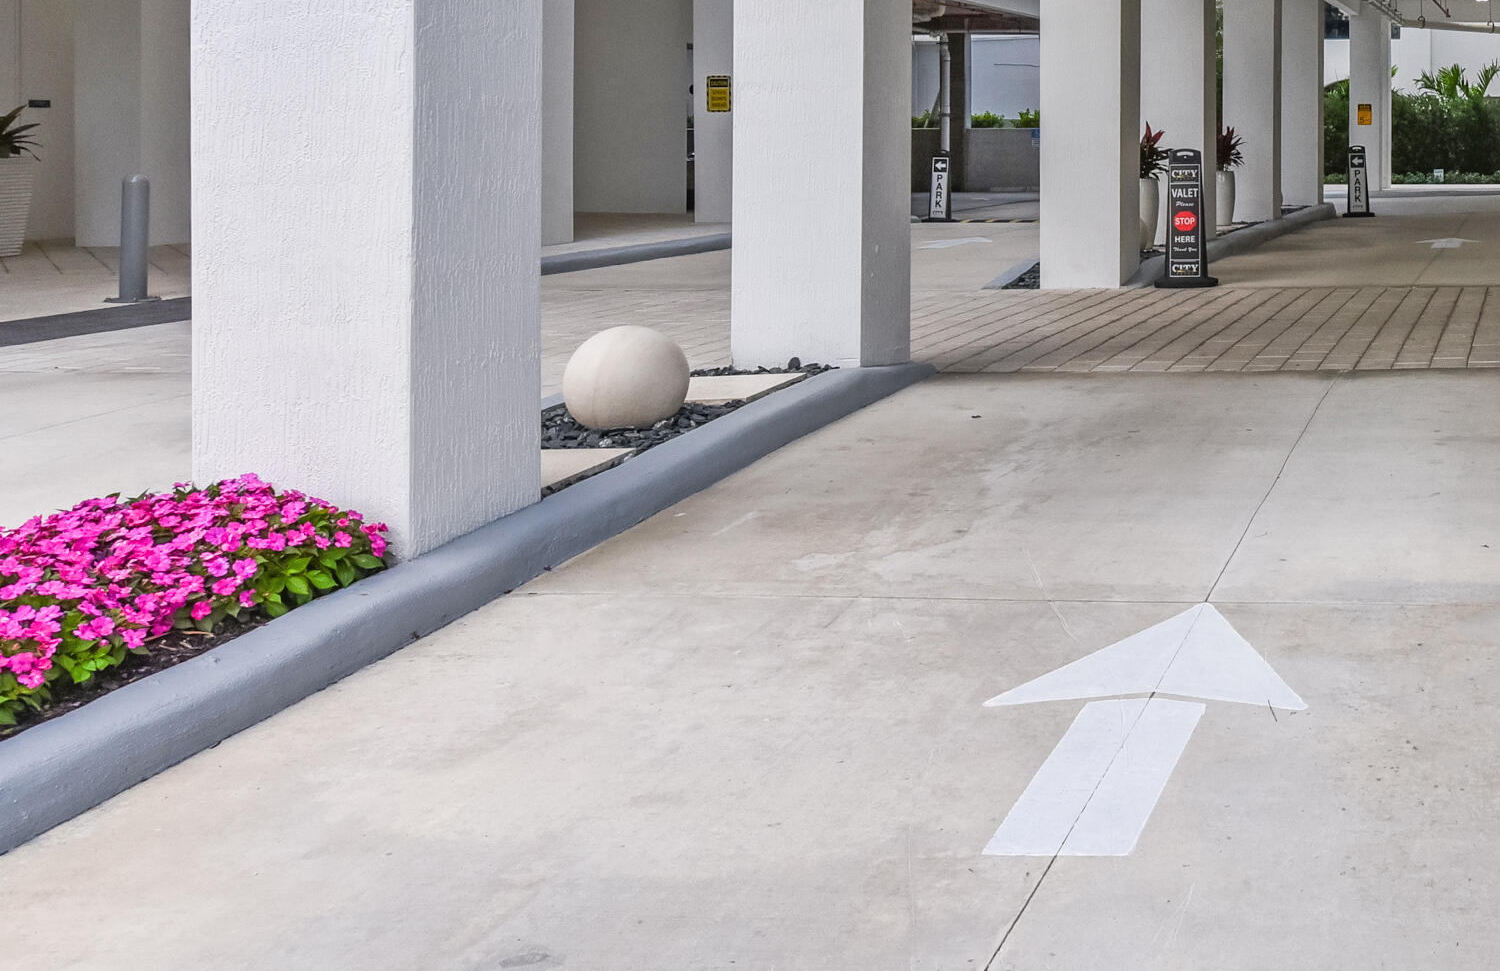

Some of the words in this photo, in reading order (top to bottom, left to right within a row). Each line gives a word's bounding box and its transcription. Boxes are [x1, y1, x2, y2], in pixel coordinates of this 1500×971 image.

[1171, 169, 1198, 178] CITY
[935, 174, 943, 208] PARK
[1171, 188, 1198, 198] VALET
[1175, 217, 1195, 226] STOP
[1174, 235, 1196, 243] HERE
[1171, 264, 1198, 273] CITY
